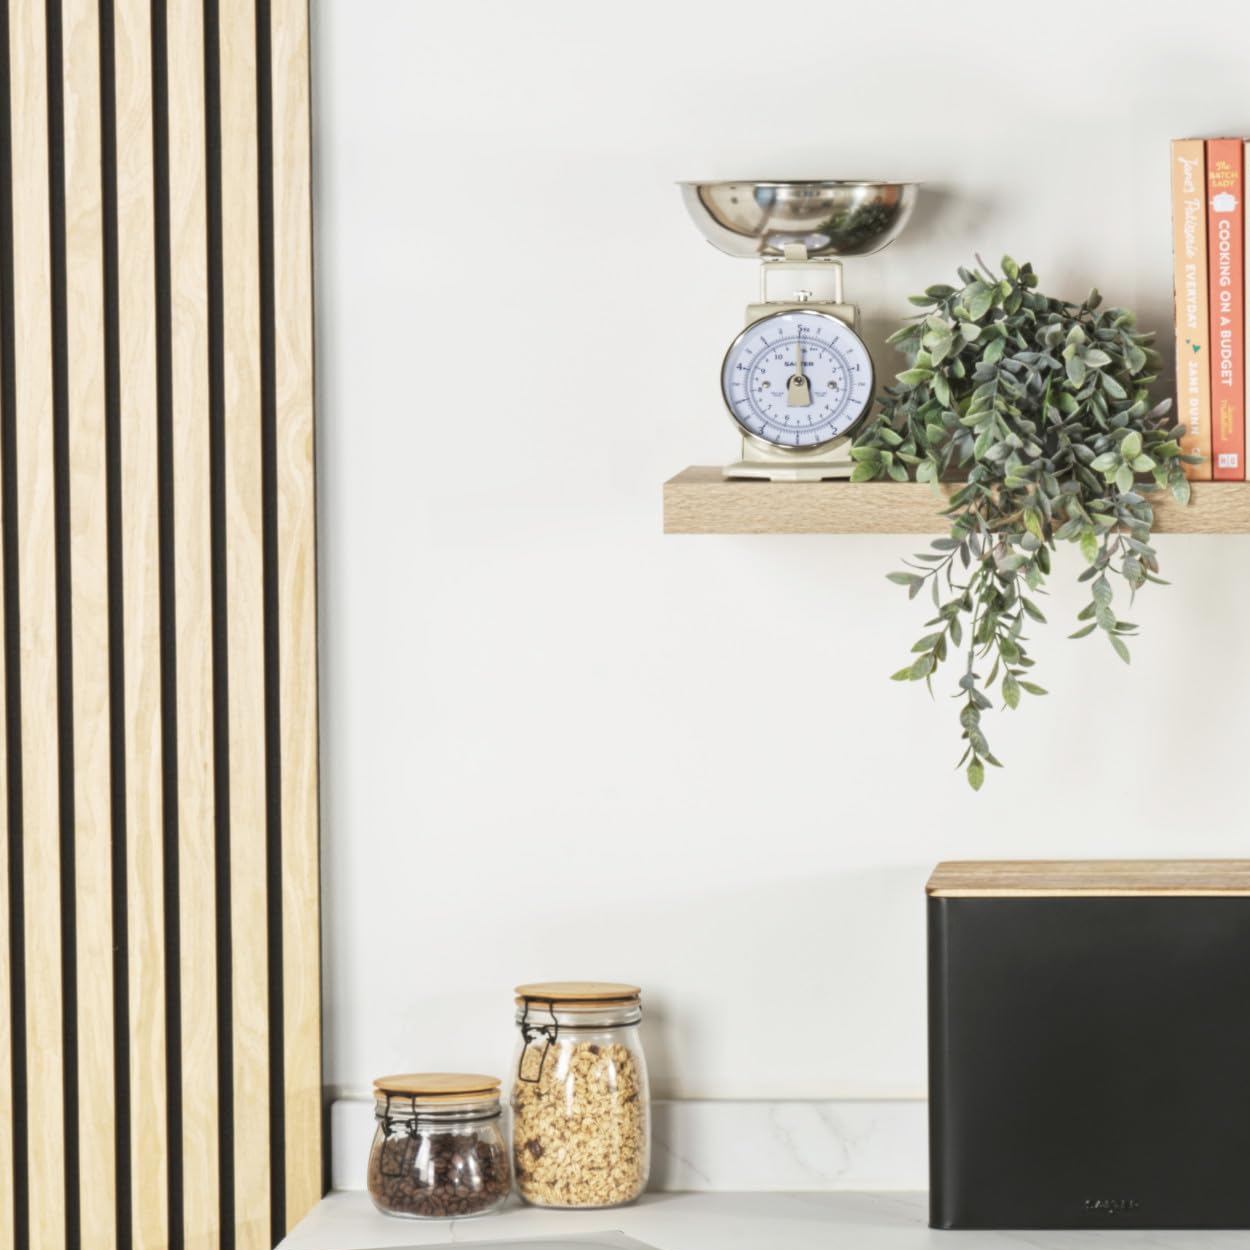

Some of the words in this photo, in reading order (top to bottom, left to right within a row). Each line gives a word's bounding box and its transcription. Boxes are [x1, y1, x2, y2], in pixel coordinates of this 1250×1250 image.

[1218, 219, 1232, 287] COOKING
[1185, 264, 1199, 329] EVERYDAY
[1219, 290, 1232, 313] ON
[1220, 316, 1231, 327] A
[1220, 329, 1232, 387] BUDGET
